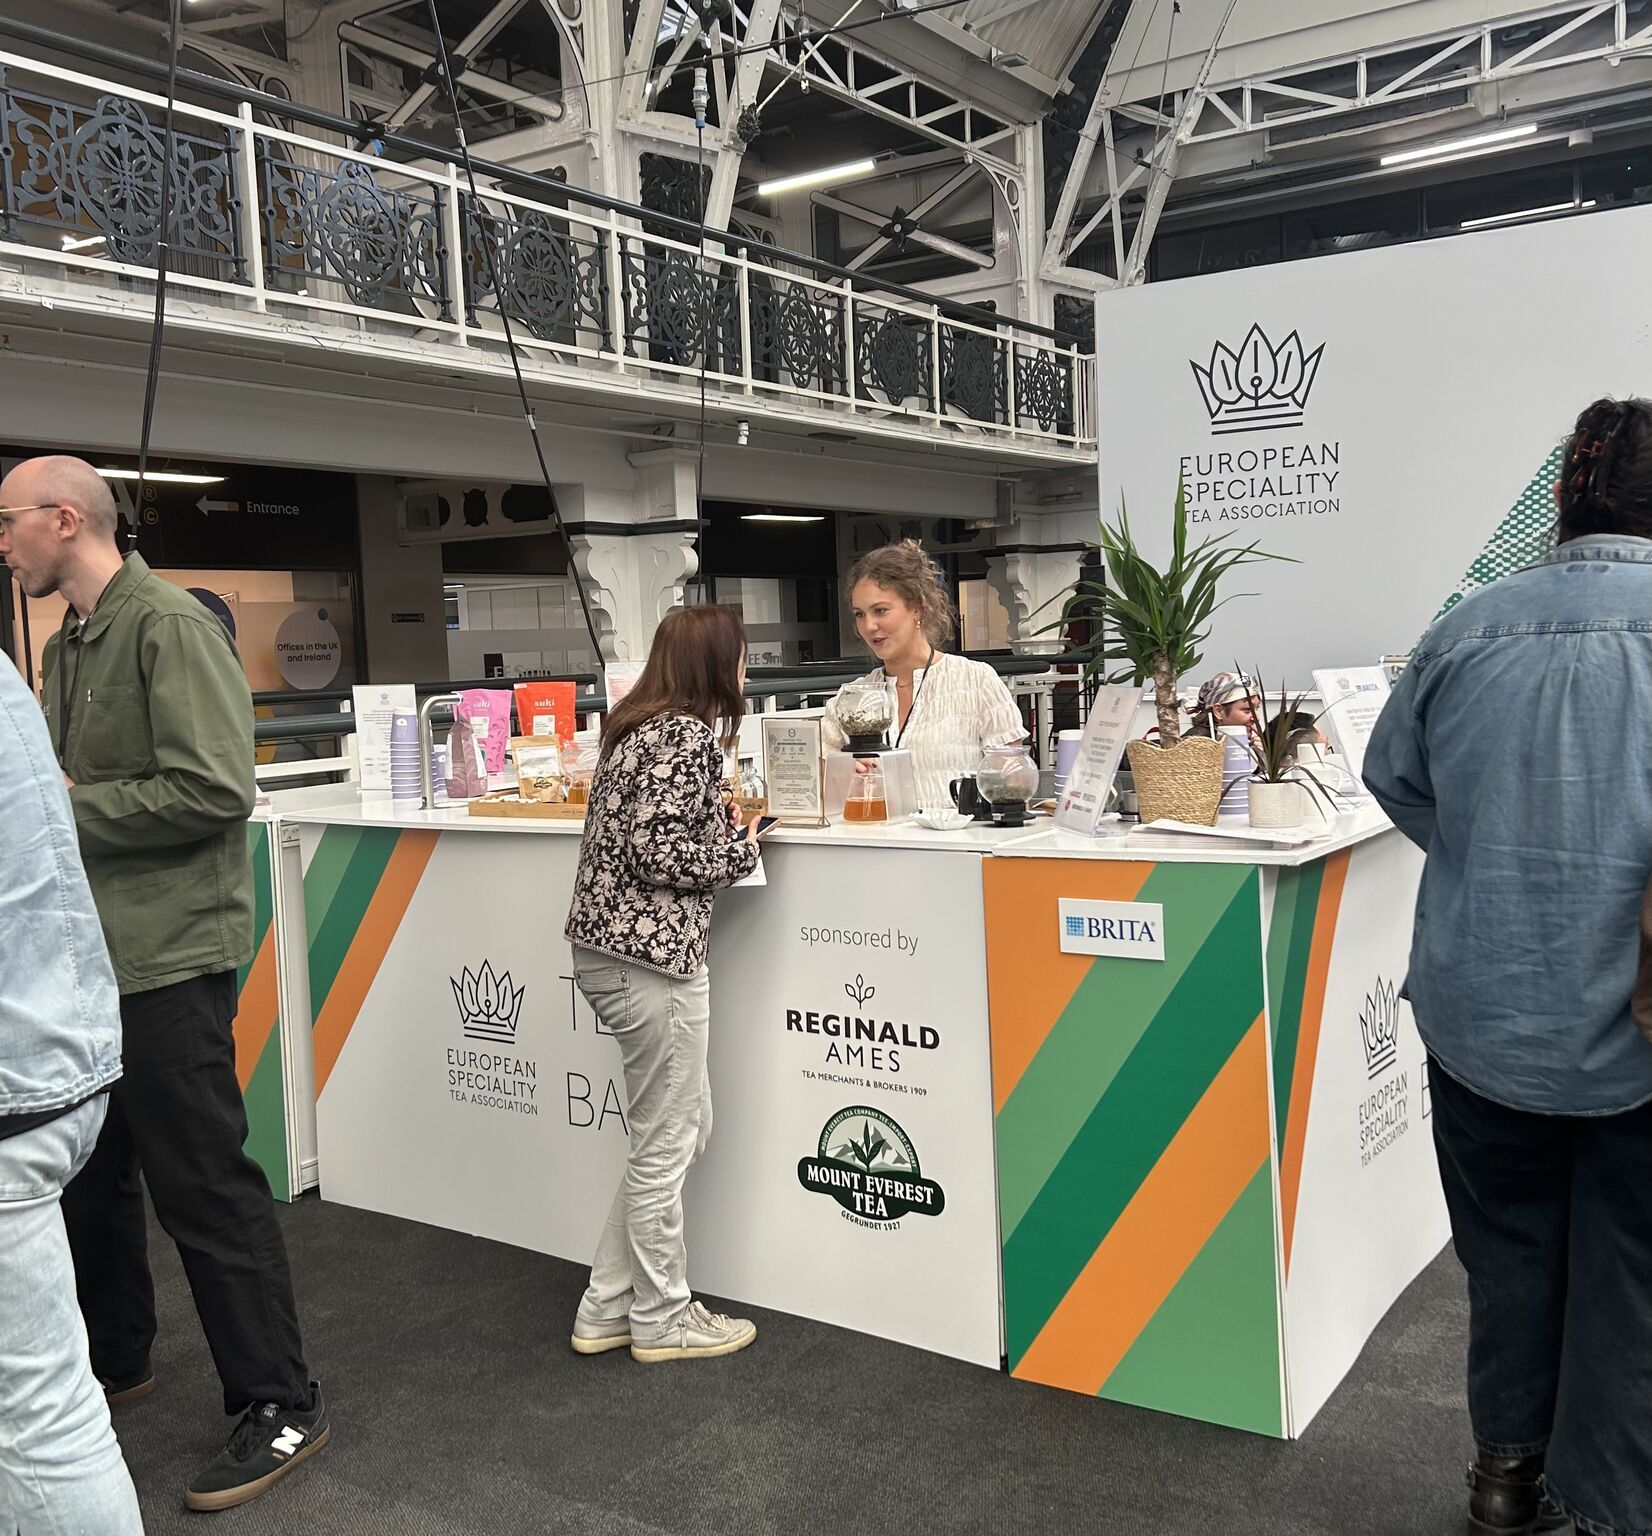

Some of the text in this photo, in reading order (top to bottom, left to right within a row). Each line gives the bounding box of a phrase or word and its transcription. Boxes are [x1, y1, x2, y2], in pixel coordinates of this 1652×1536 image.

[1180, 442, 1340, 478] EUROPEAN
[1183, 471, 1340, 504] SPECIALITY
[246, 501, 300, 516] Entrance
[1184, 499, 1340, 524] TEA ASSOCIATION
[277, 642, 339, 652] Offices in the UK
[287, 653, 331, 663] and Ireland
[534, 698, 555, 707] suki
[800, 926, 919, 956] sponsored by
[1086, 916, 1156, 943] BRITA
[786, 1009, 941, 1050] REGINALD
[447, 1048, 537, 1079] EUROPEAN
[825, 1041, 900, 1073] AMES
[448, 1069, 537, 1100] SPECIALITY
[801, 1070, 928, 1096] TEA MERCHANTS & BROKERS 1909
[449, 1089, 539, 1116] TEA ASSOCIATION
[1359, 1070, 1408, 1125] EUROPEAN
[843, 1109, 854, 1118] TEA
[853, 1108, 879, 1118] COMPANY
[1359, 1095, 1409, 1151] SPECIALITY
[1360, 1118, 1409, 1168] TEA ASSOCIATION
[807, 1164, 934, 1205] MOUNT EVEREST
[852, 1190, 889, 1217] TEA
[883, 1221, 901, 1231] 1927
